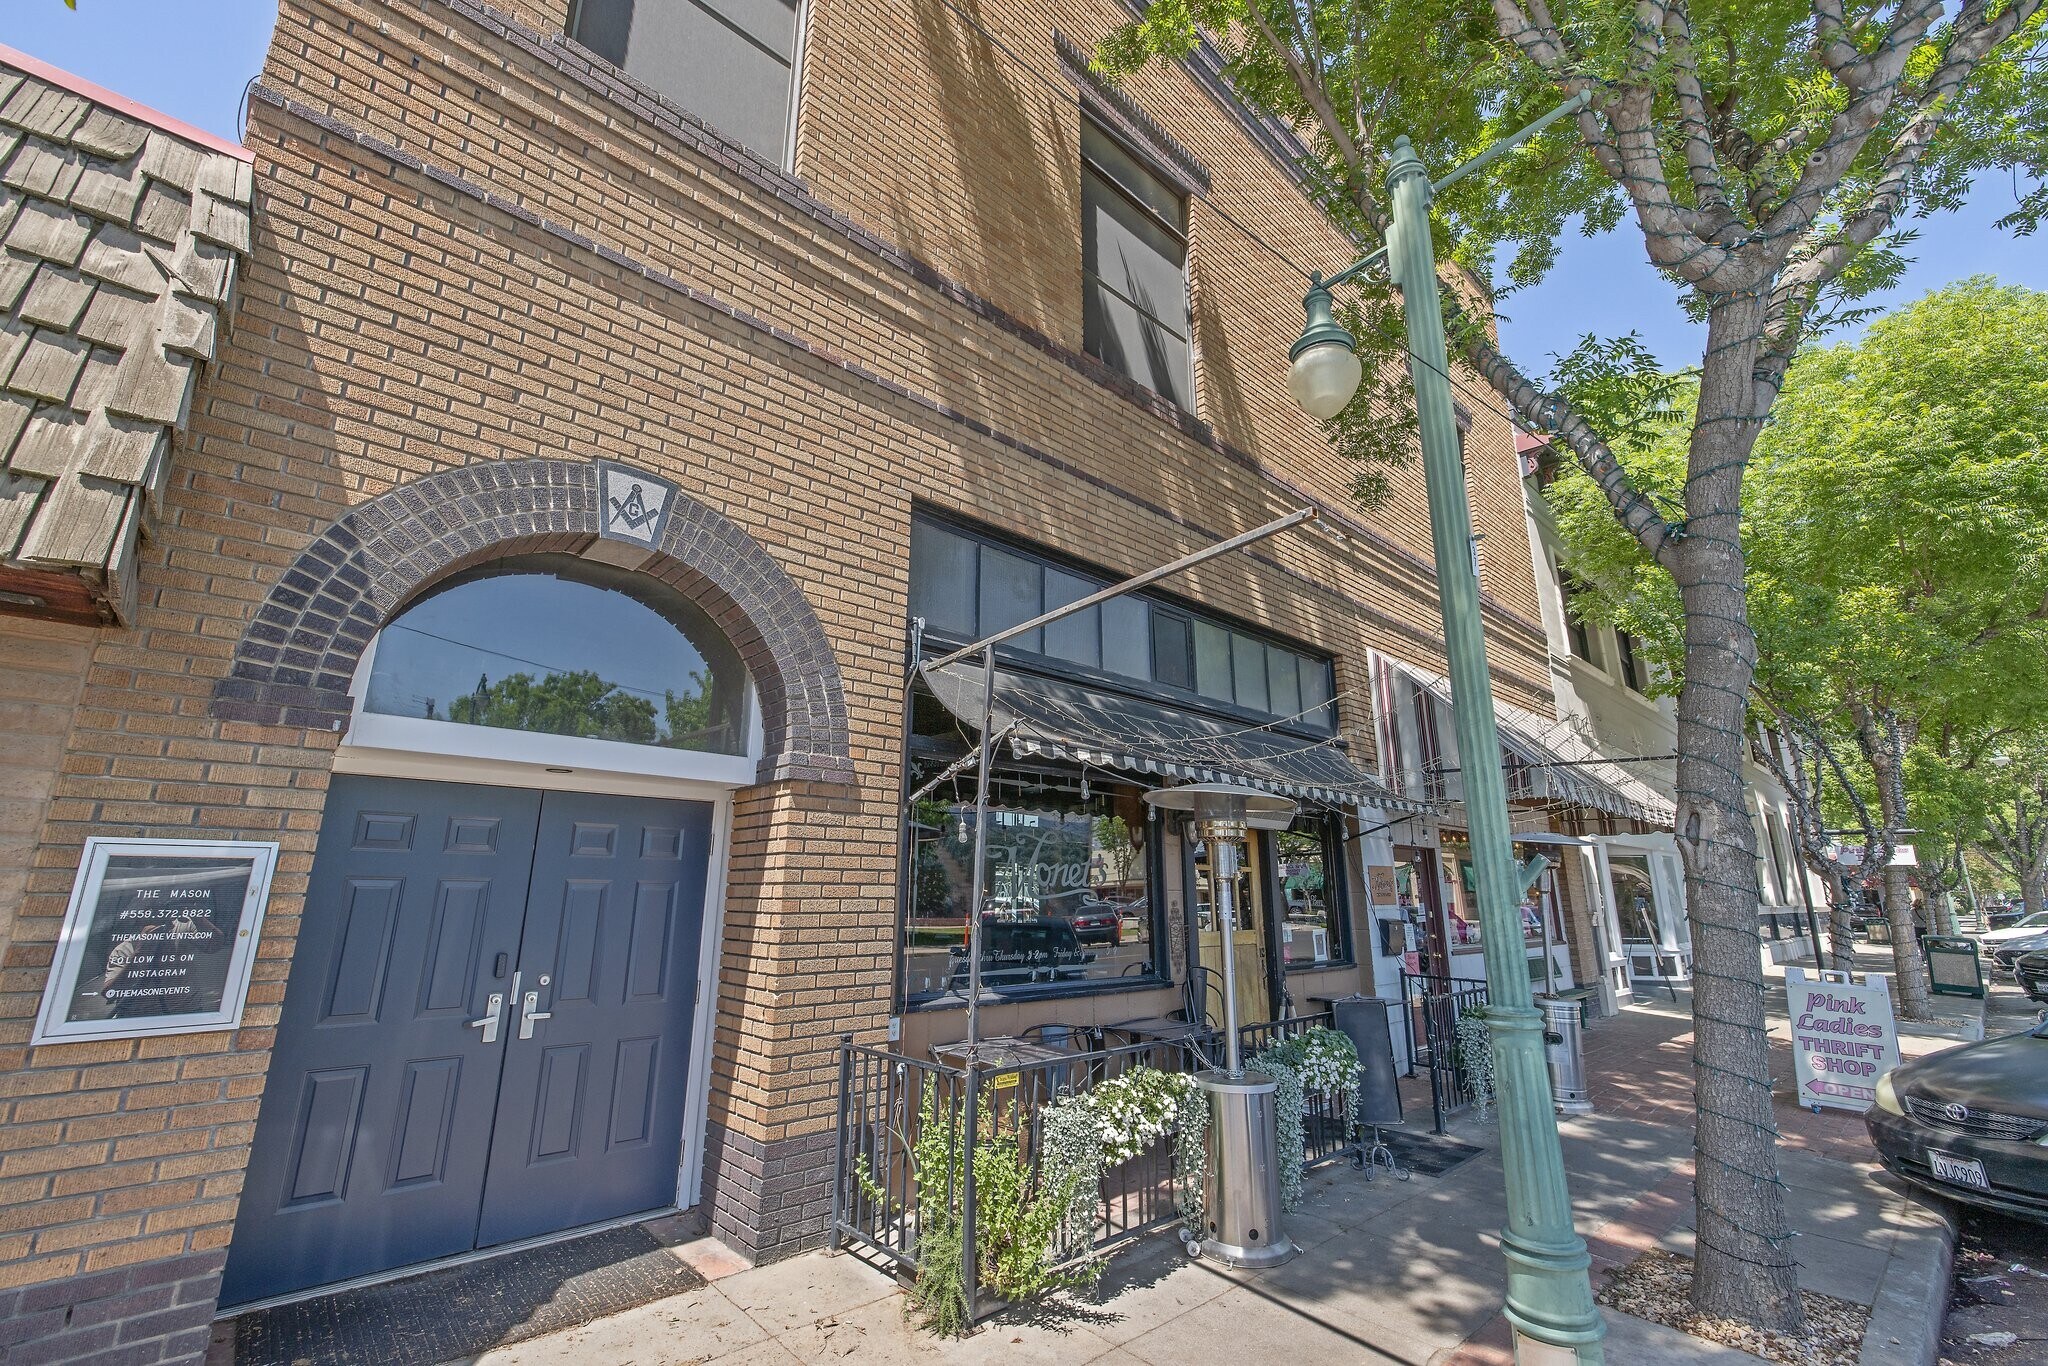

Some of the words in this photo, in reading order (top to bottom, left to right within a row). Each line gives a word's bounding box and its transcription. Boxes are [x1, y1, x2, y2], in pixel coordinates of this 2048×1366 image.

[136, 889, 161, 899] THE
[169, 889, 211, 899] MASON
[110, 955, 154, 965] FOLLOW
[161, 955, 176, 963] US
[180, 954, 194, 962] ON
[127, 968, 187, 978] INSTAGRAM
[105, 986, 190, 999] @THEMASONEVENTS
[1806, 992, 1866, 1015] Pink
[1796, 1013, 1883, 1038] Ladies
[1798, 1036, 1885, 1060] THRIFT
[1812, 1055, 1877, 1077] SHOP
[1823, 1084, 1876, 1101] OPEN
